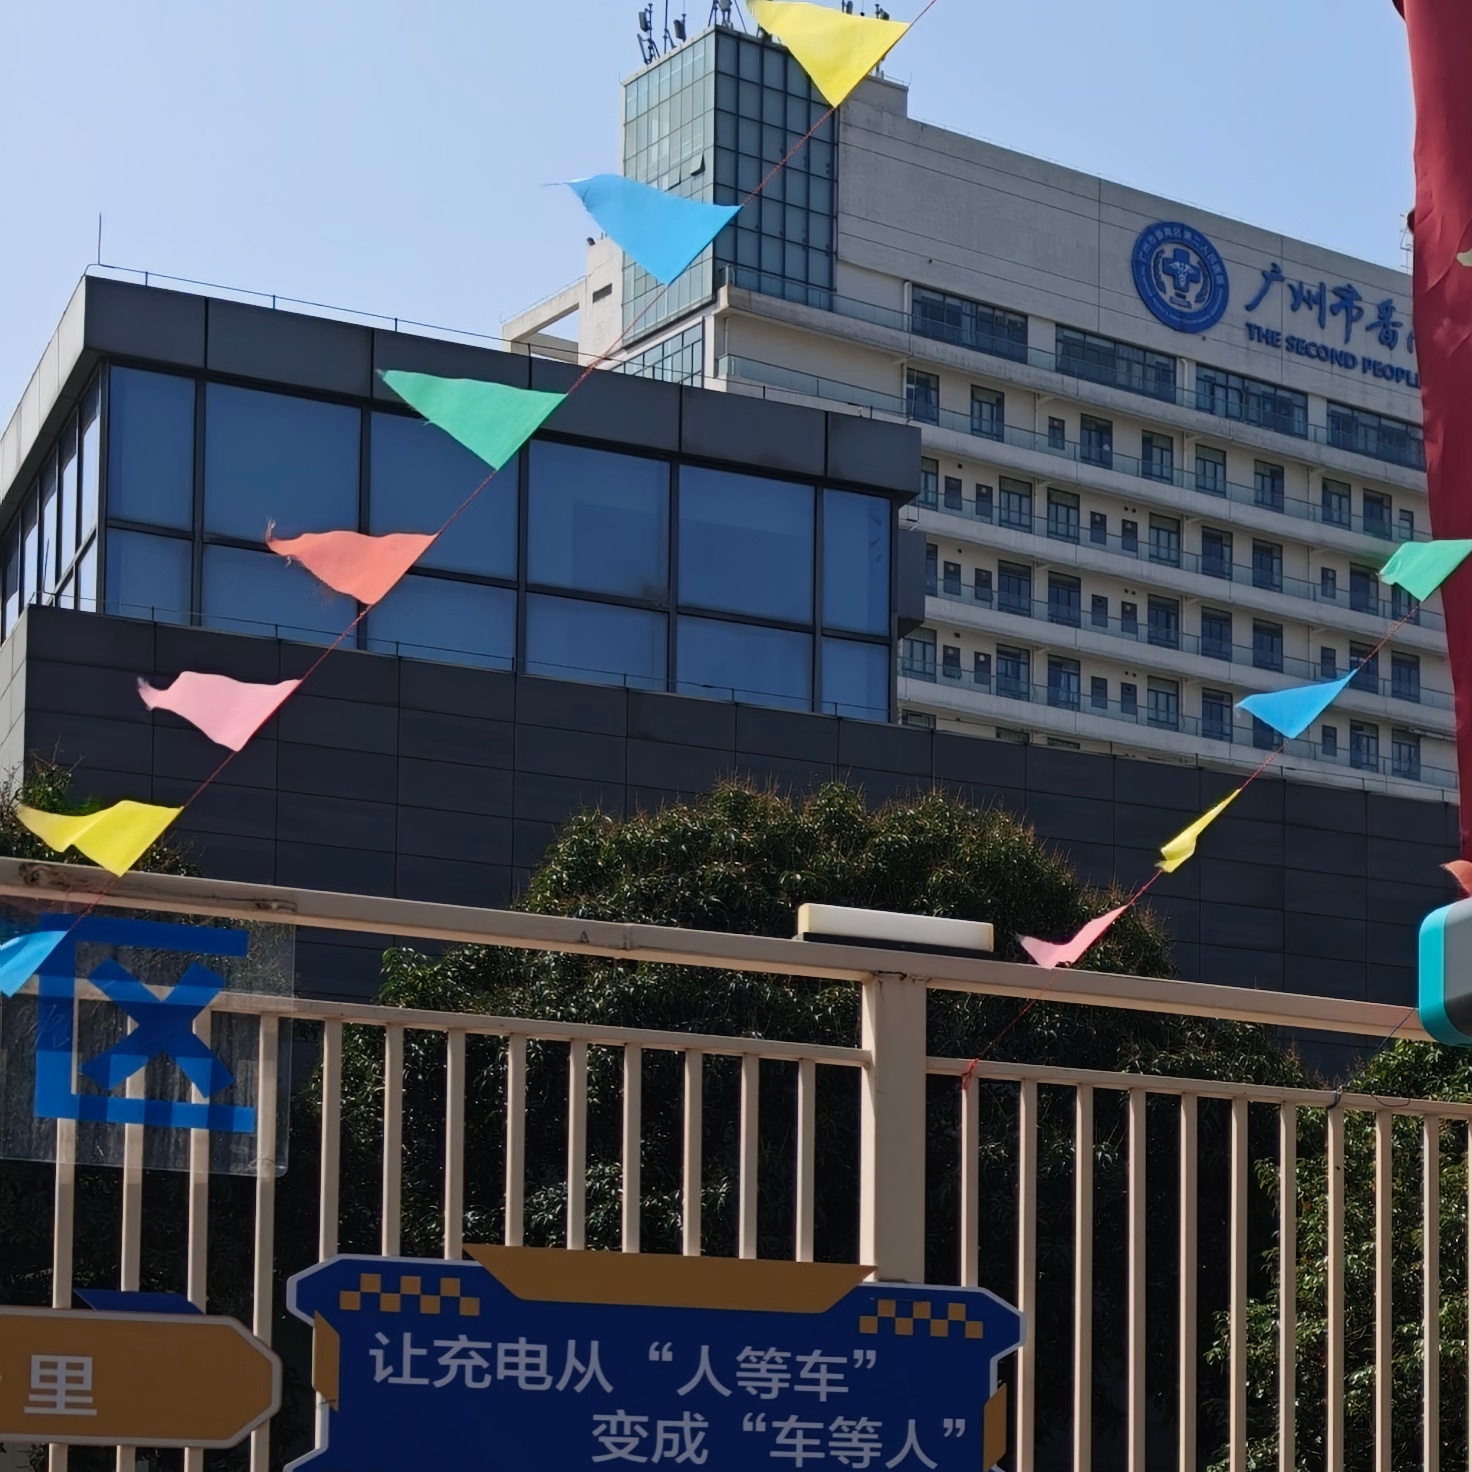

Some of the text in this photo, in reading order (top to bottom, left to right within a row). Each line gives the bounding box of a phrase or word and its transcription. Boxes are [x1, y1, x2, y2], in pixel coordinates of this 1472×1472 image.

[1245, 262, 1415, 354] 广州市番
[1245, 322, 1282, 349] THE
[1285, 335, 1358, 370] SECOND
[24, 1354, 98, 1416] 里
